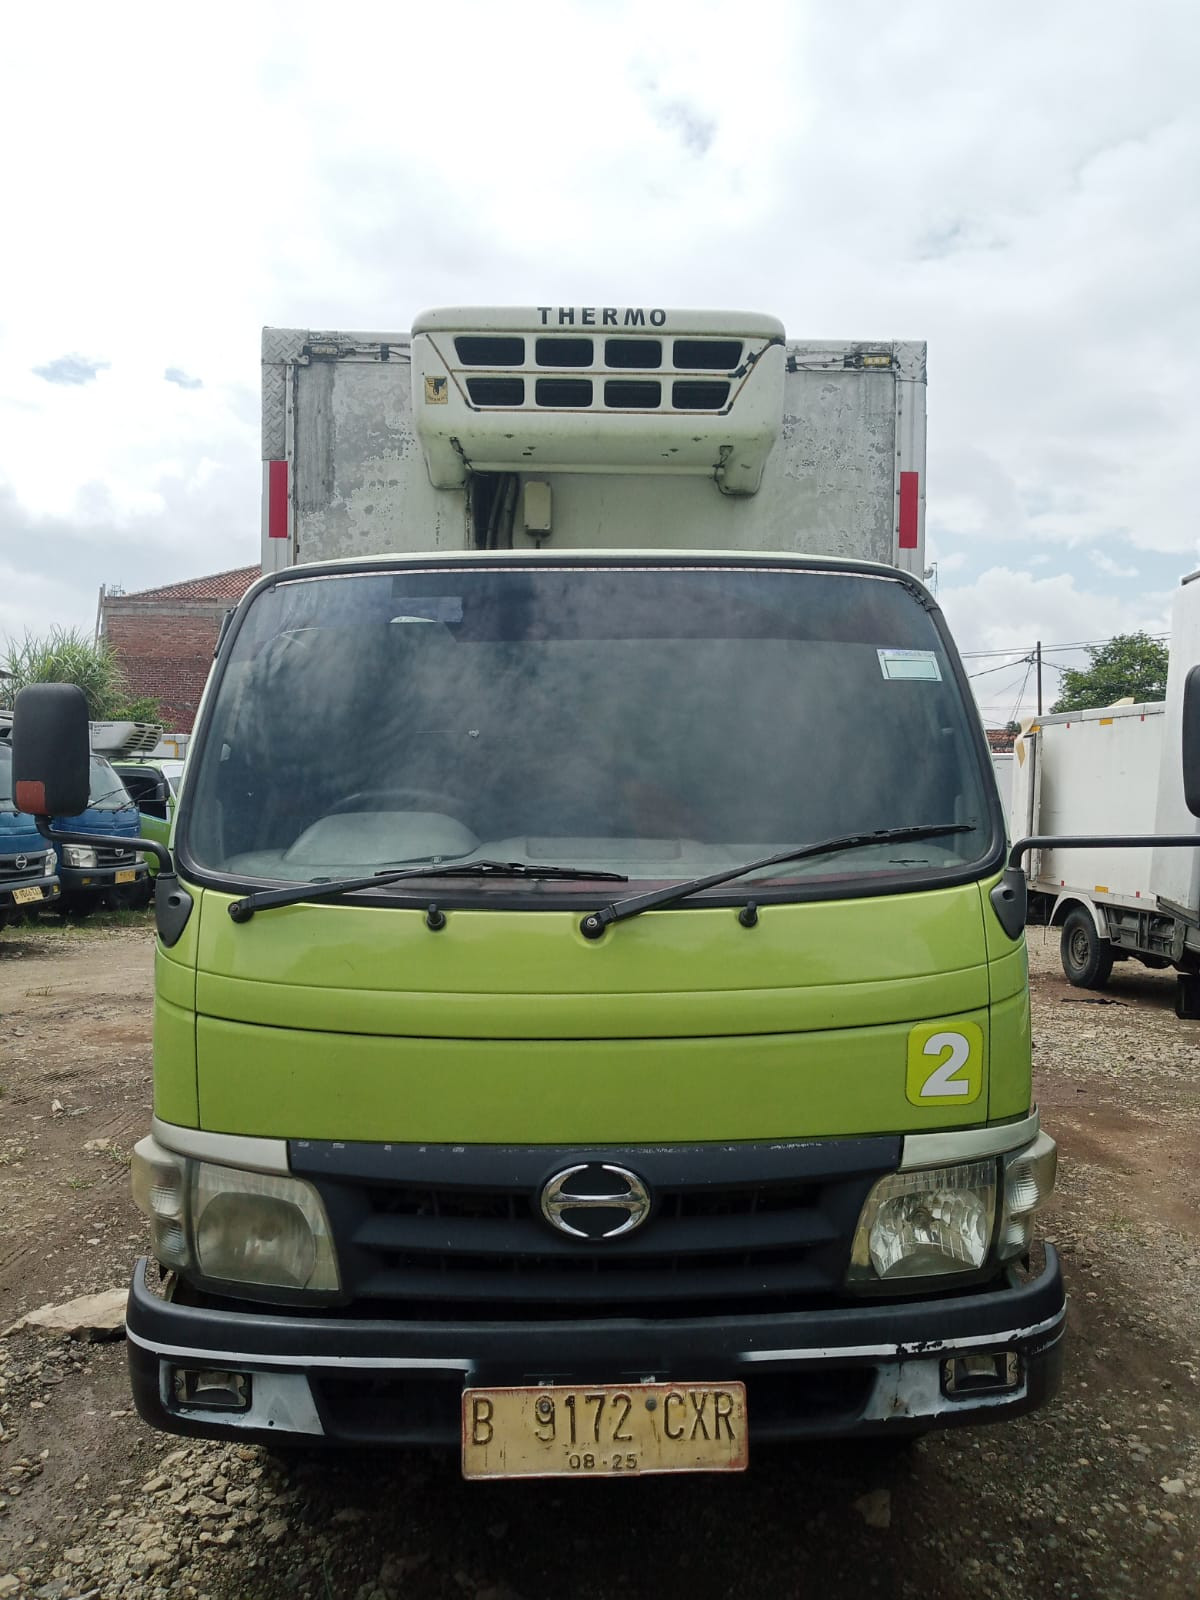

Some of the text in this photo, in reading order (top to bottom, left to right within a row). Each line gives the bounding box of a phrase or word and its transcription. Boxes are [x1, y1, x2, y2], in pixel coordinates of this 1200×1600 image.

[537, 307, 666, 327] THERMO
[919, 1032, 970, 1097] 2
[472, 1391, 736, 1446] B 9172 CXR
